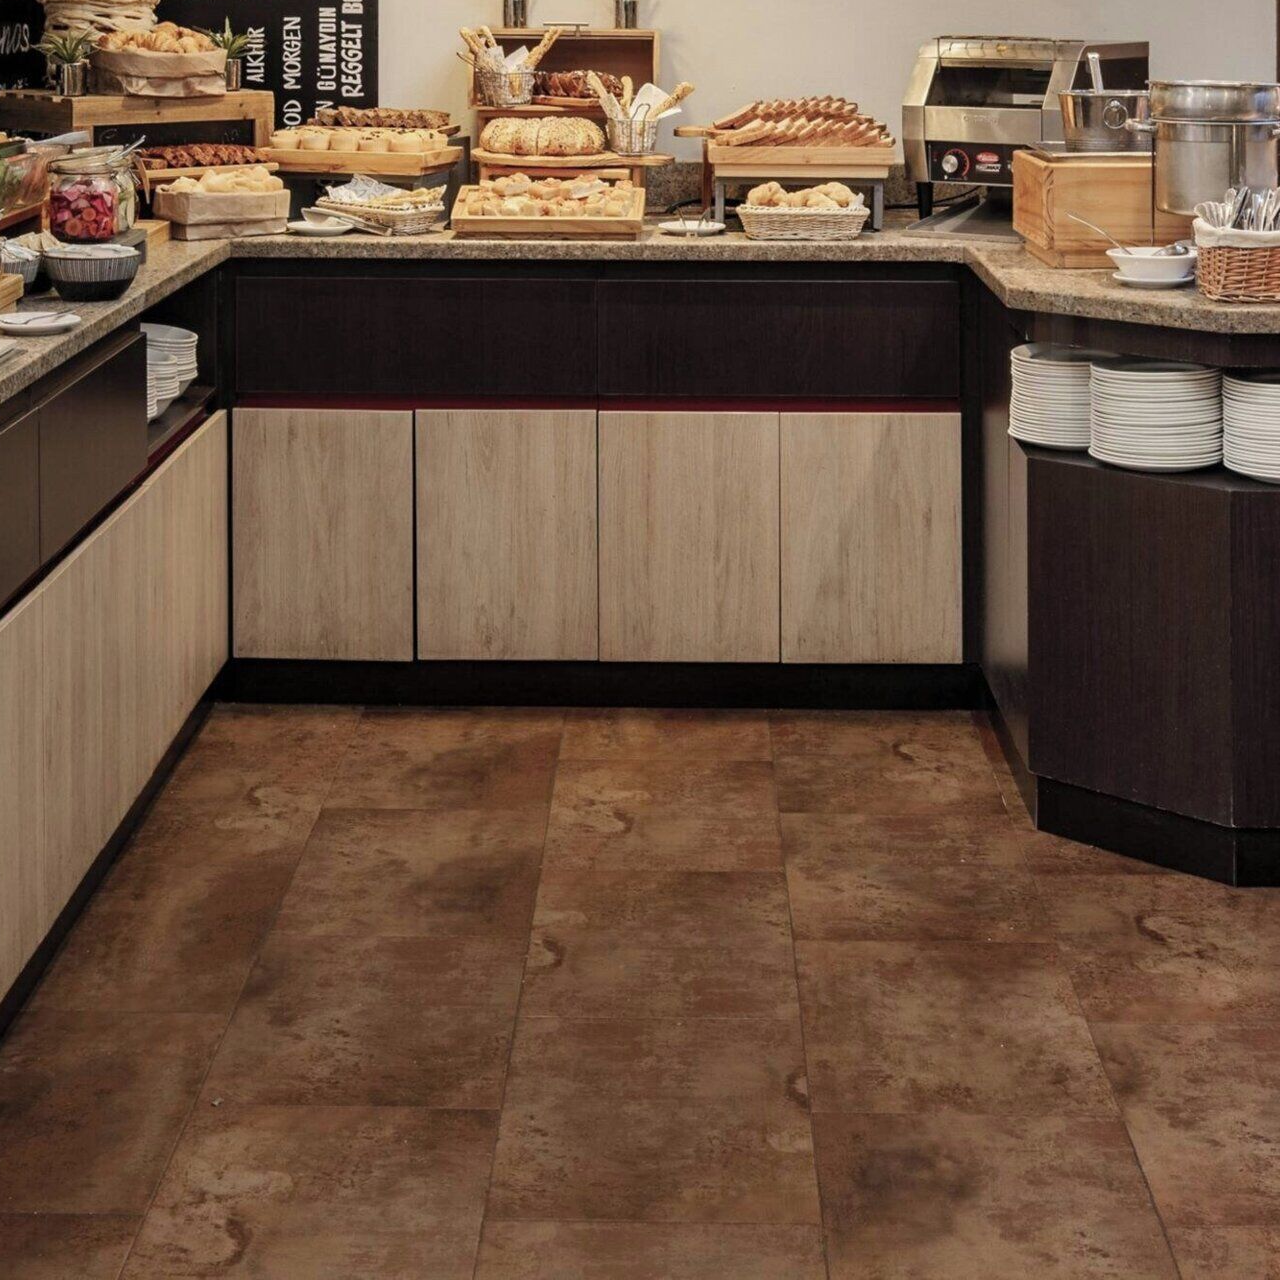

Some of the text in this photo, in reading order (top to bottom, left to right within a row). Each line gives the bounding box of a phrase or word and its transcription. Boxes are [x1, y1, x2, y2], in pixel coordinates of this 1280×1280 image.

[246, 26, 265, 83] ALKHIR
[282, 16, 302, 90] MORGEN
[340, 20, 365, 98] REGGELT
